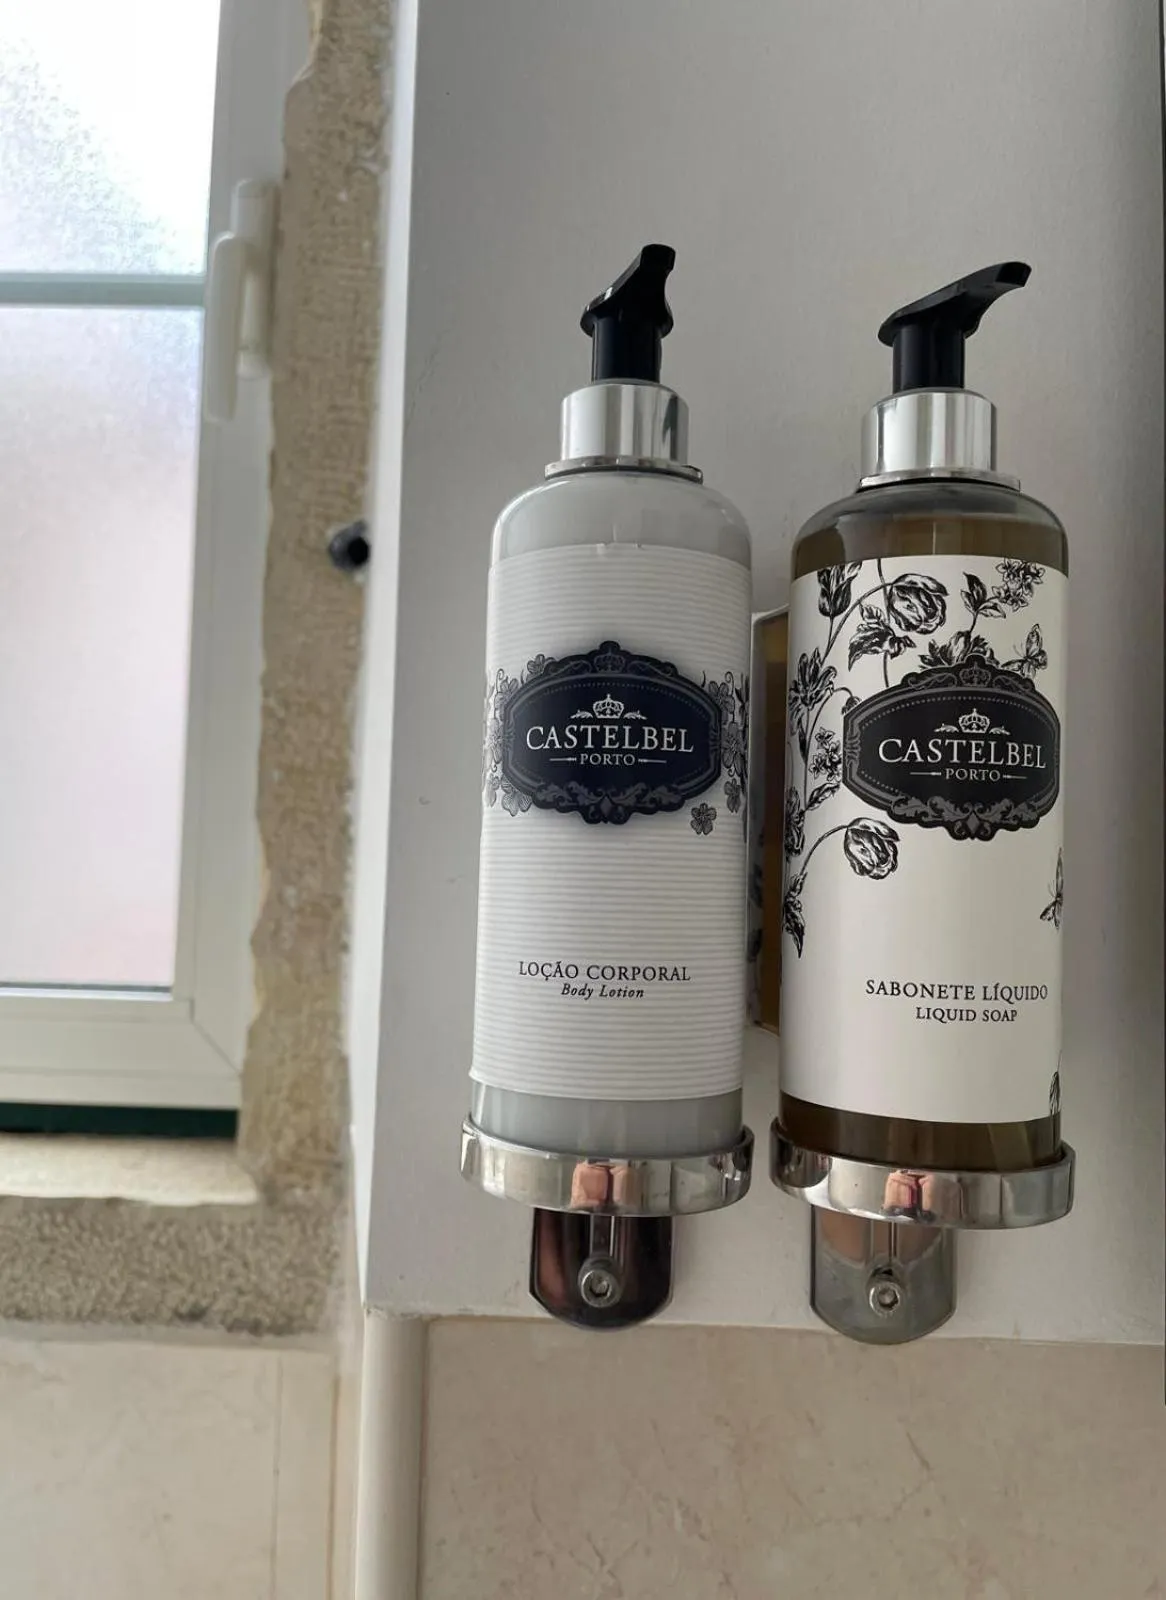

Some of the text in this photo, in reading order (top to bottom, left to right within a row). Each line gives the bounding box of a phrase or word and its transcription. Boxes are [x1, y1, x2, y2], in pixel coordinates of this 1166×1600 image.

[526, 724, 694, 753] CASTELBEL
[580, 753, 636, 766] PORTO
[878, 738, 1047, 769] CASTELBEL
[945, 768, 1001, 782] PORTO
[519, 961, 691, 982] LOÇÃO CORPORAL
[561, 982, 644, 1000] Body Lotion
[865, 979, 1048, 1004] SABONETE LÍQUIDO
[916, 1007, 1018, 1023] LIQUID SOAP
